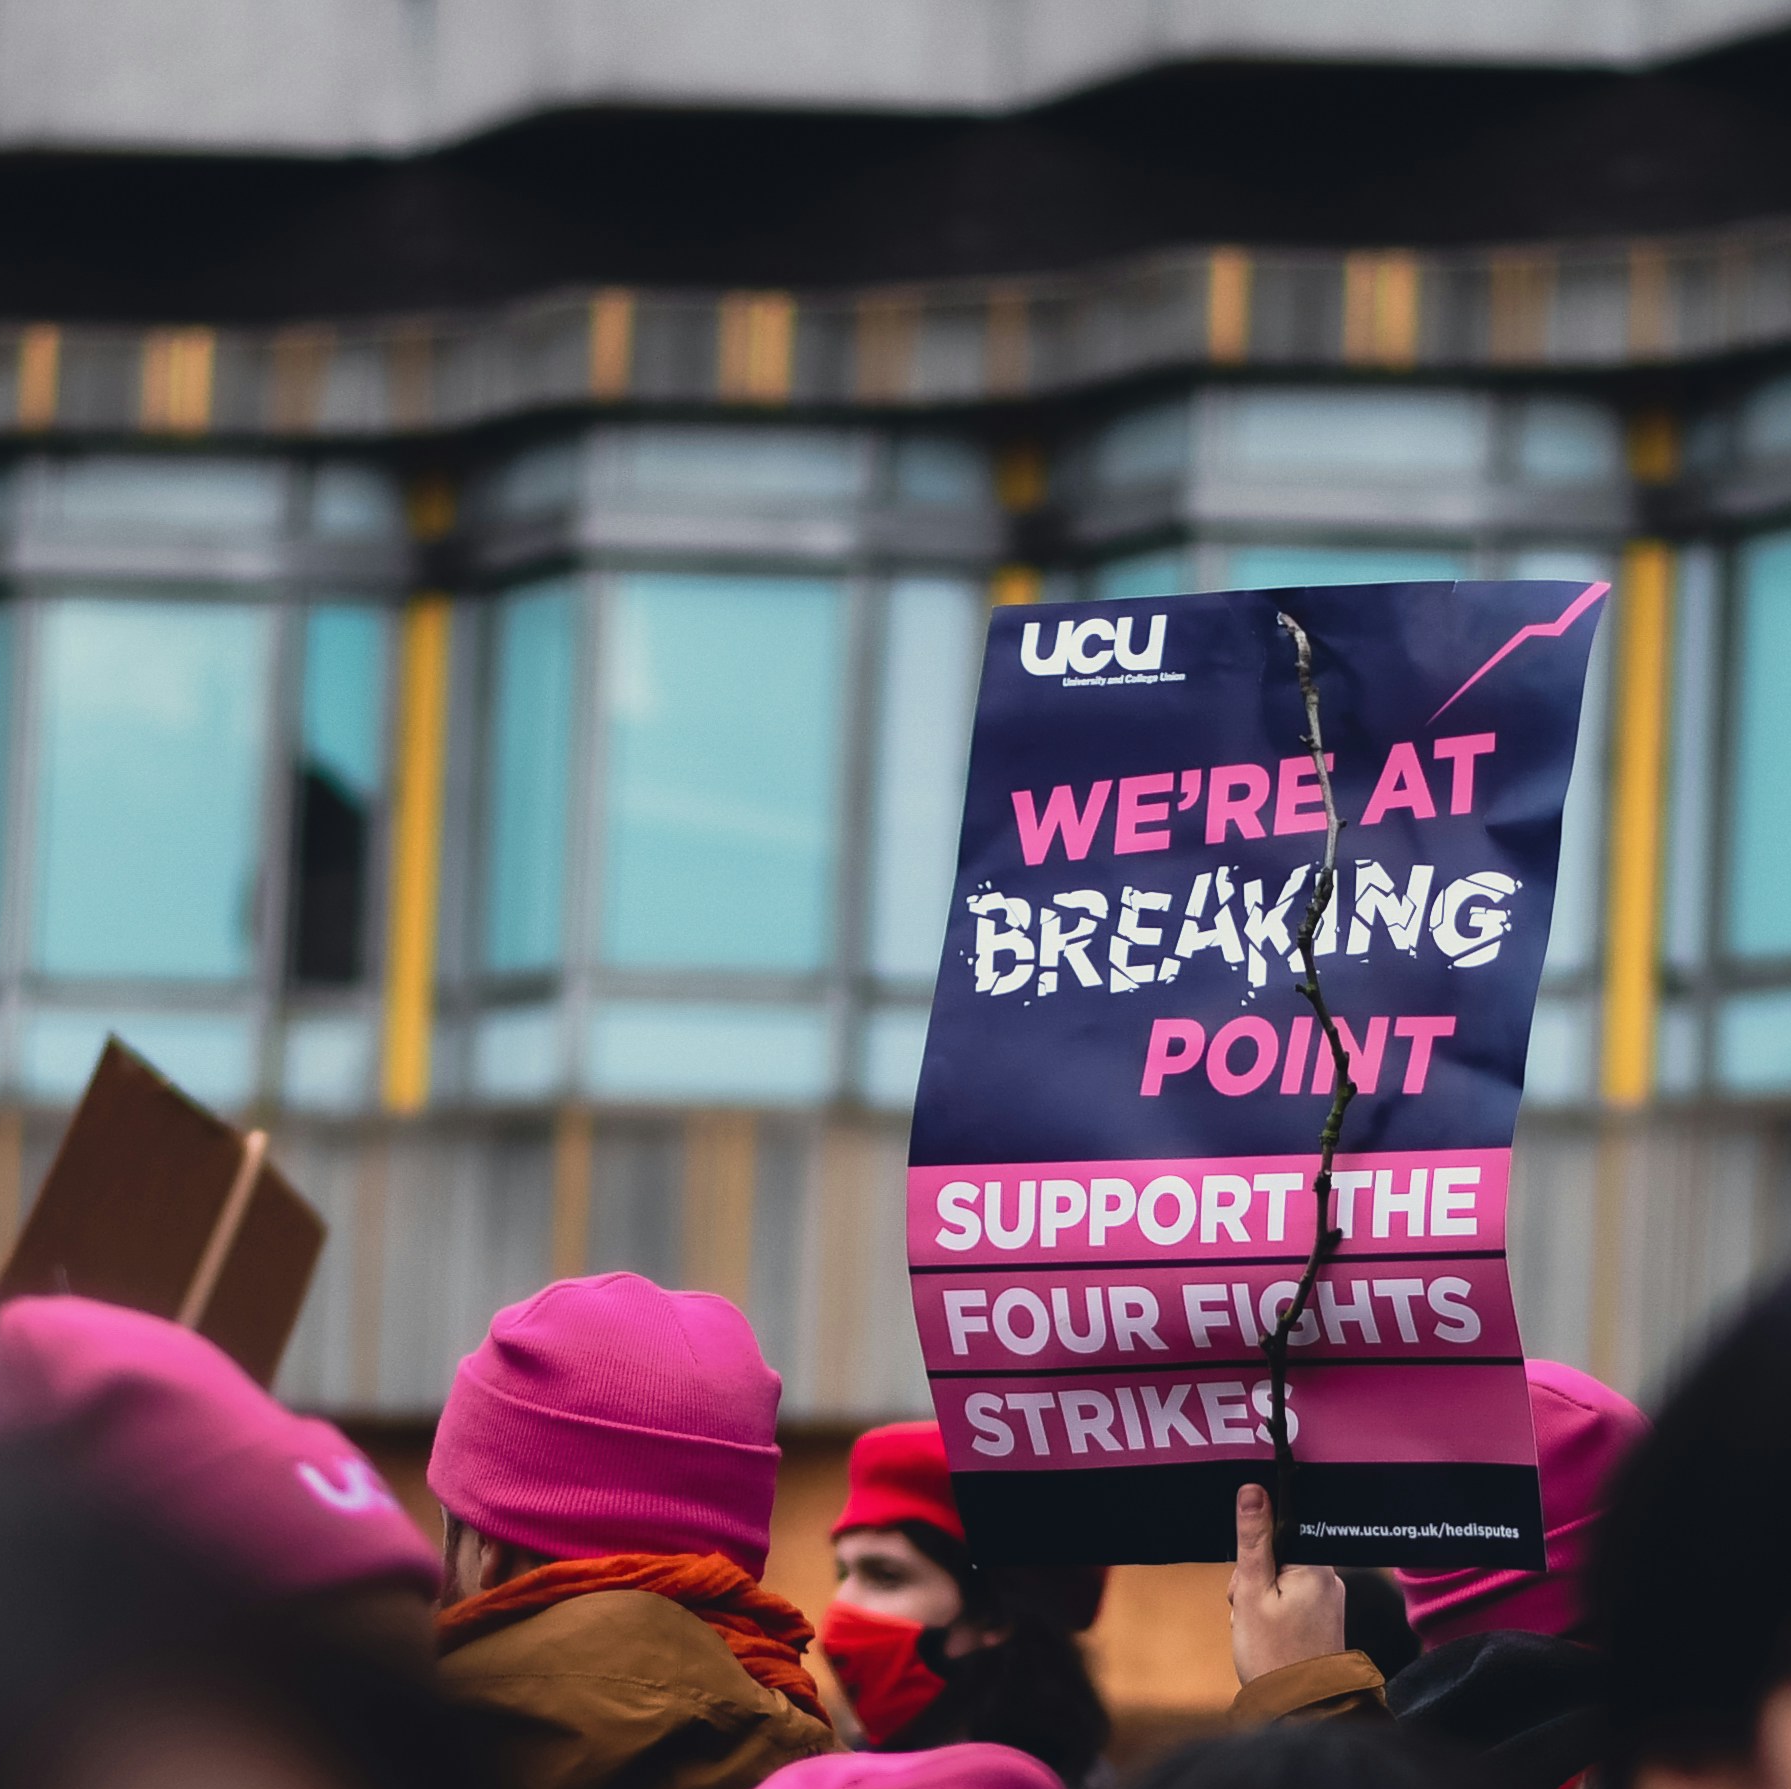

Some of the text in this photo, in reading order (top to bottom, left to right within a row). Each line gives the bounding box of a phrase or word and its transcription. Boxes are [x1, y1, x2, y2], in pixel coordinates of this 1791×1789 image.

[1020, 614, 1168, 676] UCU
[1062, 671, 1186, 687] University and College Union
[1011, 732, 1497, 867] WE'RE AT
[965, 860, 1524, 1004] BREAKING
[1139, 1015, 1457, 1097] POINT
[934, 1166, 1482, 1252] SUPPORT THE
[942, 1276, 1482, 1356] FOUR FIGHTS
[965, 1379, 1300, 1456] STRIKES
[1299, 1521, 1520, 1539] ps://www.ucu.org.uk/hedisputes
